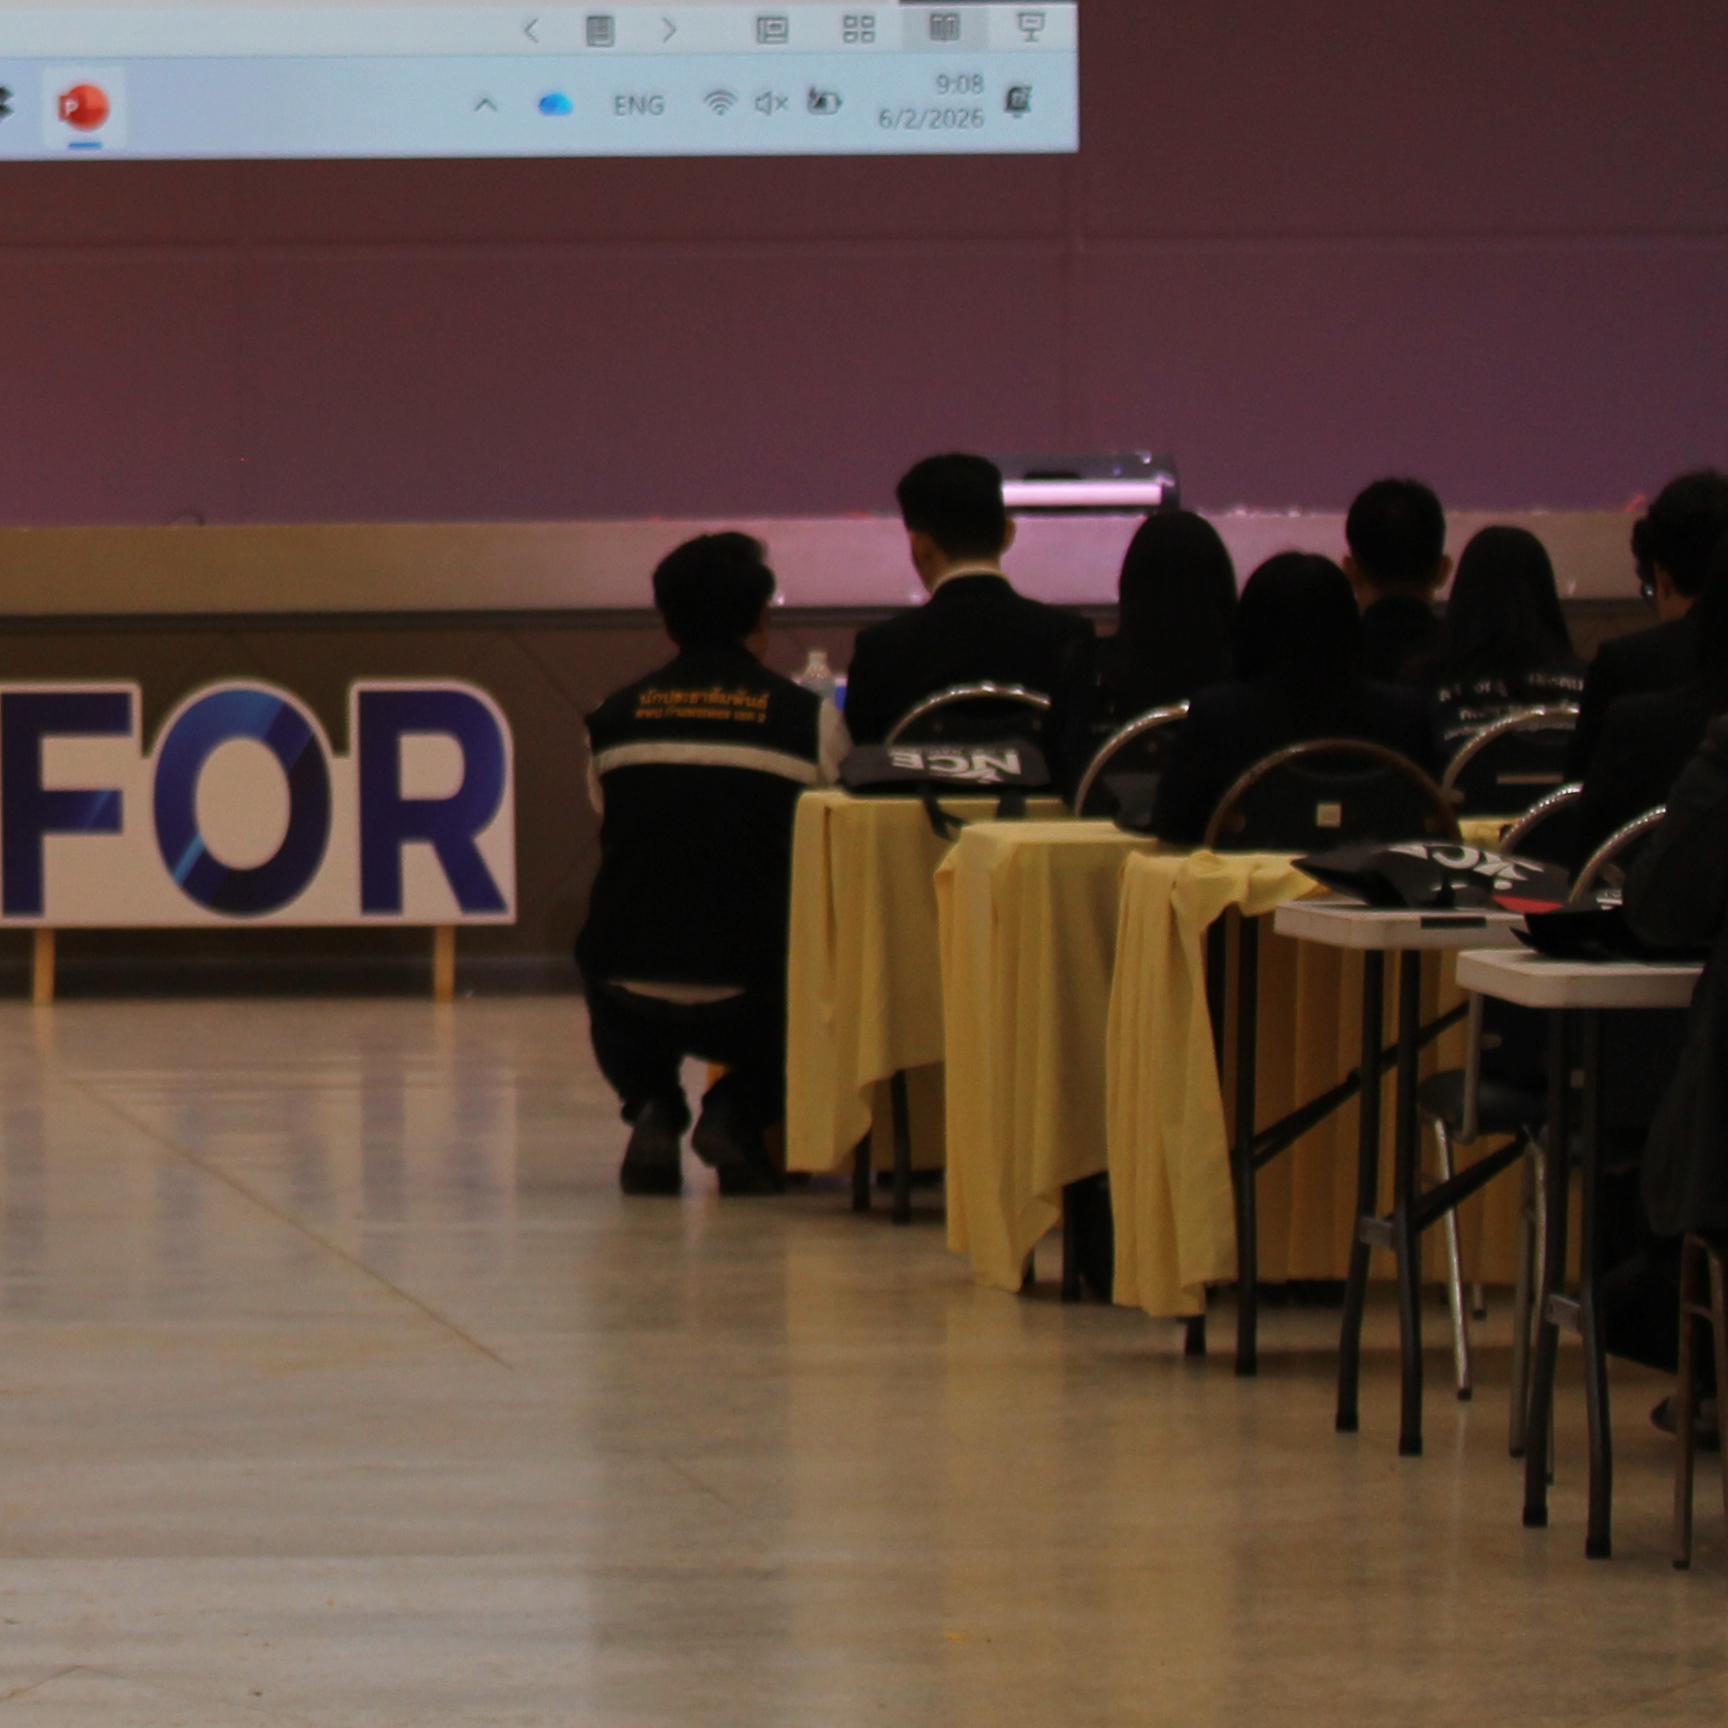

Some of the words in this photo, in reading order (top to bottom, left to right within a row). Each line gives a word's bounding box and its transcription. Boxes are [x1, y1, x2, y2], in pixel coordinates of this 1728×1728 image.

[935, 73, 984, 95] 9:08
[614, 94, 665, 116] ENG
[877, 107, 985, 130] 6/2/2026
